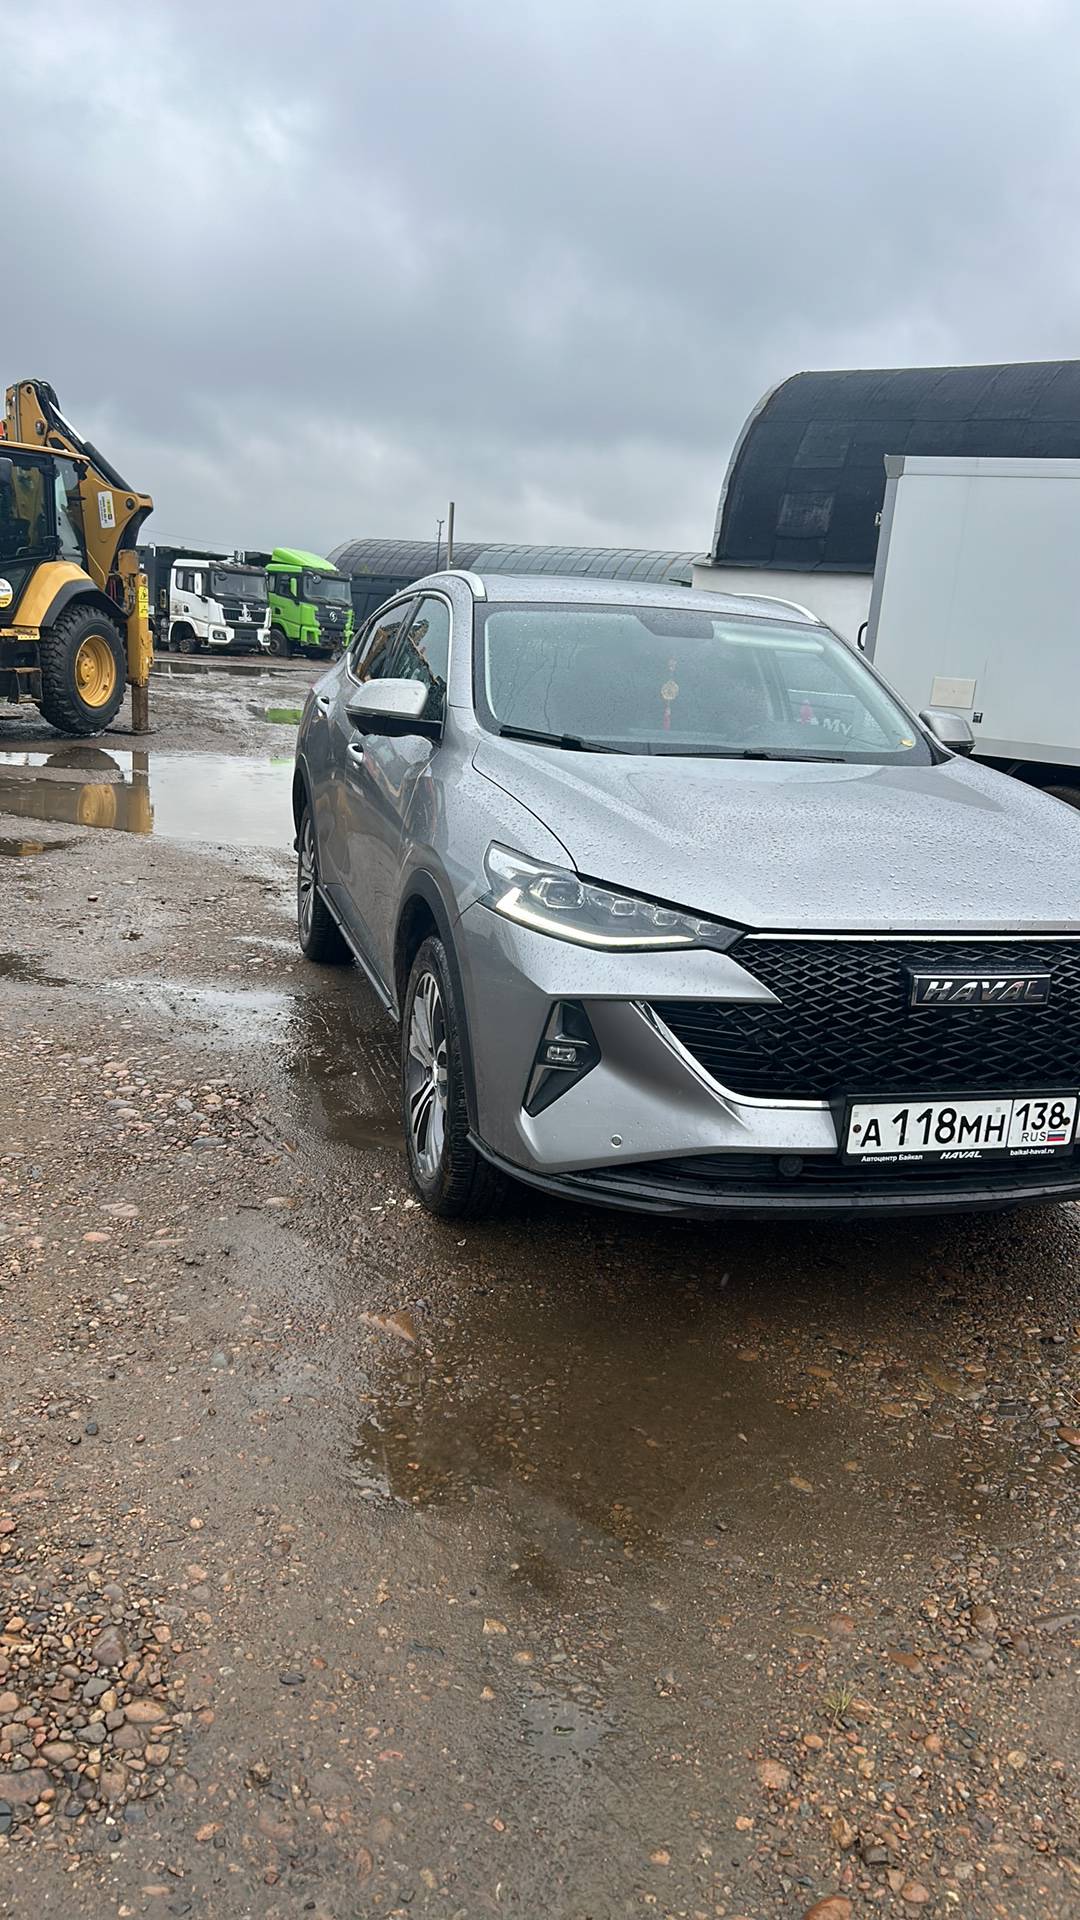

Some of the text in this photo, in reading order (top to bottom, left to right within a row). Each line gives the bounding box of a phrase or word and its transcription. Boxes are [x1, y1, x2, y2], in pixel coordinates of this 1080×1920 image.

[922, 981, 1044, 1001] HAVAL
[1015, 1101, 1065, 1132] 138
[1021, 1131, 1047, 1142] RUS
[940, 1150, 982, 1160] HAVAL
[1009, 1147, 1055, 1156] baikal-haval.ru
[861, 1153, 923, 1163] Автоцентр Байкал
